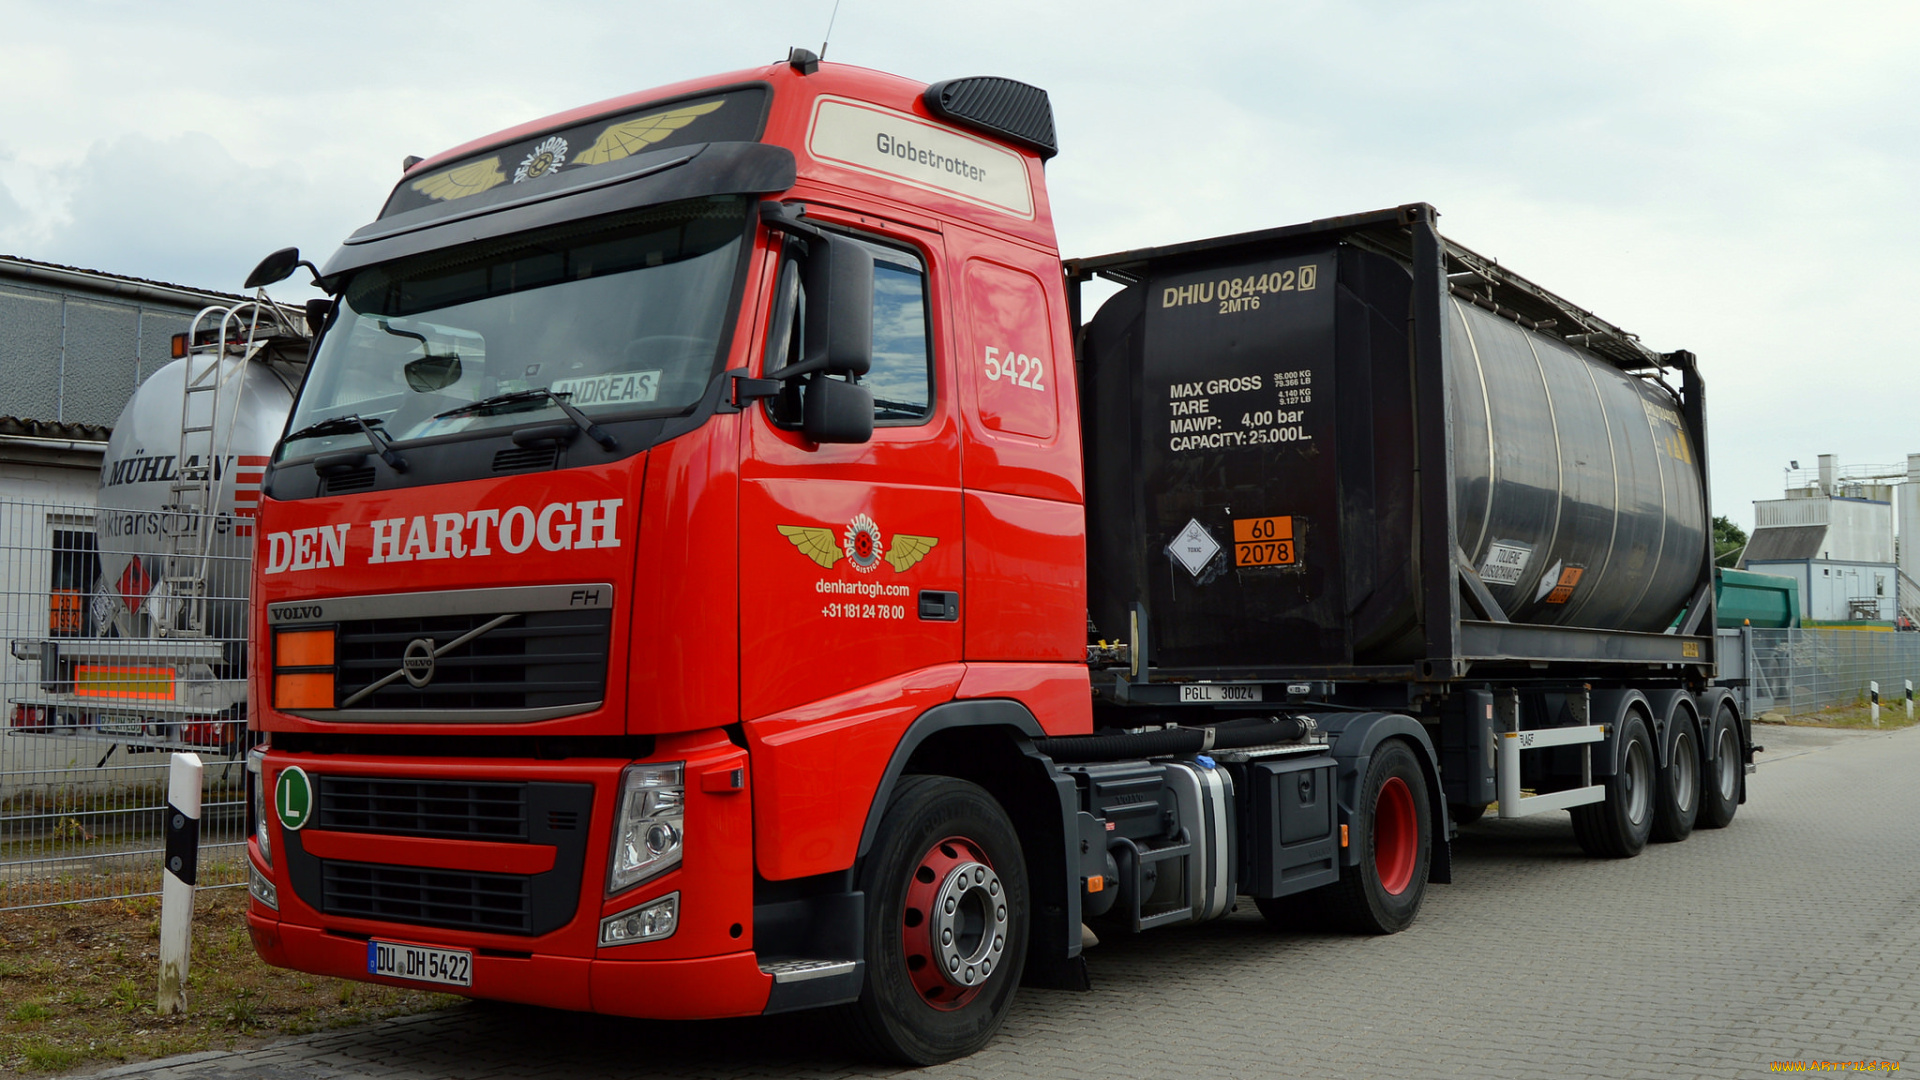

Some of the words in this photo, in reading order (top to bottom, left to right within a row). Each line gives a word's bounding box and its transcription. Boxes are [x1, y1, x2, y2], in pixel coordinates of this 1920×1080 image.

[513, 153, 535, 184] DEN
[535, 136, 569, 174] HARTOGH
[876, 132, 986, 182] Globetrotter
[1162, 281, 1215, 308] DHIU
[1217, 270, 1295, 300] 084402
[1300, 266, 1315, 290] 0
[1218, 296, 1261, 315] 2MT6
[984, 345, 1045, 392] 5422
[1299, 369, 1311, 378] KG
[559, 374, 651, 404] ANDREAS
[1170, 381, 1204, 399] MAX
[1206, 375, 1262, 395] GROSS
[1300, 377, 1311, 385] LB
[1299, 387, 1311, 396] KG
[1300, 395, 1311, 403] LB
[1170, 398, 1209, 416] TARE
[1170, 415, 1222, 434] MAWP:
[1241, 410, 1273, 428] 4,00
[1277, 409, 1304, 424] bar
[1170, 431, 1247, 452] CAPACITY:
[265, 523, 351, 575] DEN
[368, 498, 624, 565] HARTOGH
[843, 524, 857, 558] DEN
[851, 513, 884, 561] HARTOGH
[1251, 519, 1275, 539] 60
[1240, 543, 1289, 564] 2078
[848, 557, 881, 574] LOGISTICS
[569, 589, 599, 606] FH
[815, 578, 910, 598] denhartogh.com
[271, 605, 323, 620] VOLVO
[822, 603, 842, 618] +31
[843, 603, 860, 618] 181
[862, 604, 876, 618] 24
[877, 604, 890, 619] 78
[891, 605, 905, 619] 00
[404, 659, 432, 667] VOLVO
[1185, 686, 1212, 700] PGLL
[1221, 686, 1254, 700] 30024
[285, 779, 300, 818] L
[1115, 793, 1145, 804] VOLVO
[377, 946, 396, 972] DU
[406, 949, 426, 977] DH
[429, 952, 469, 981] 5422
